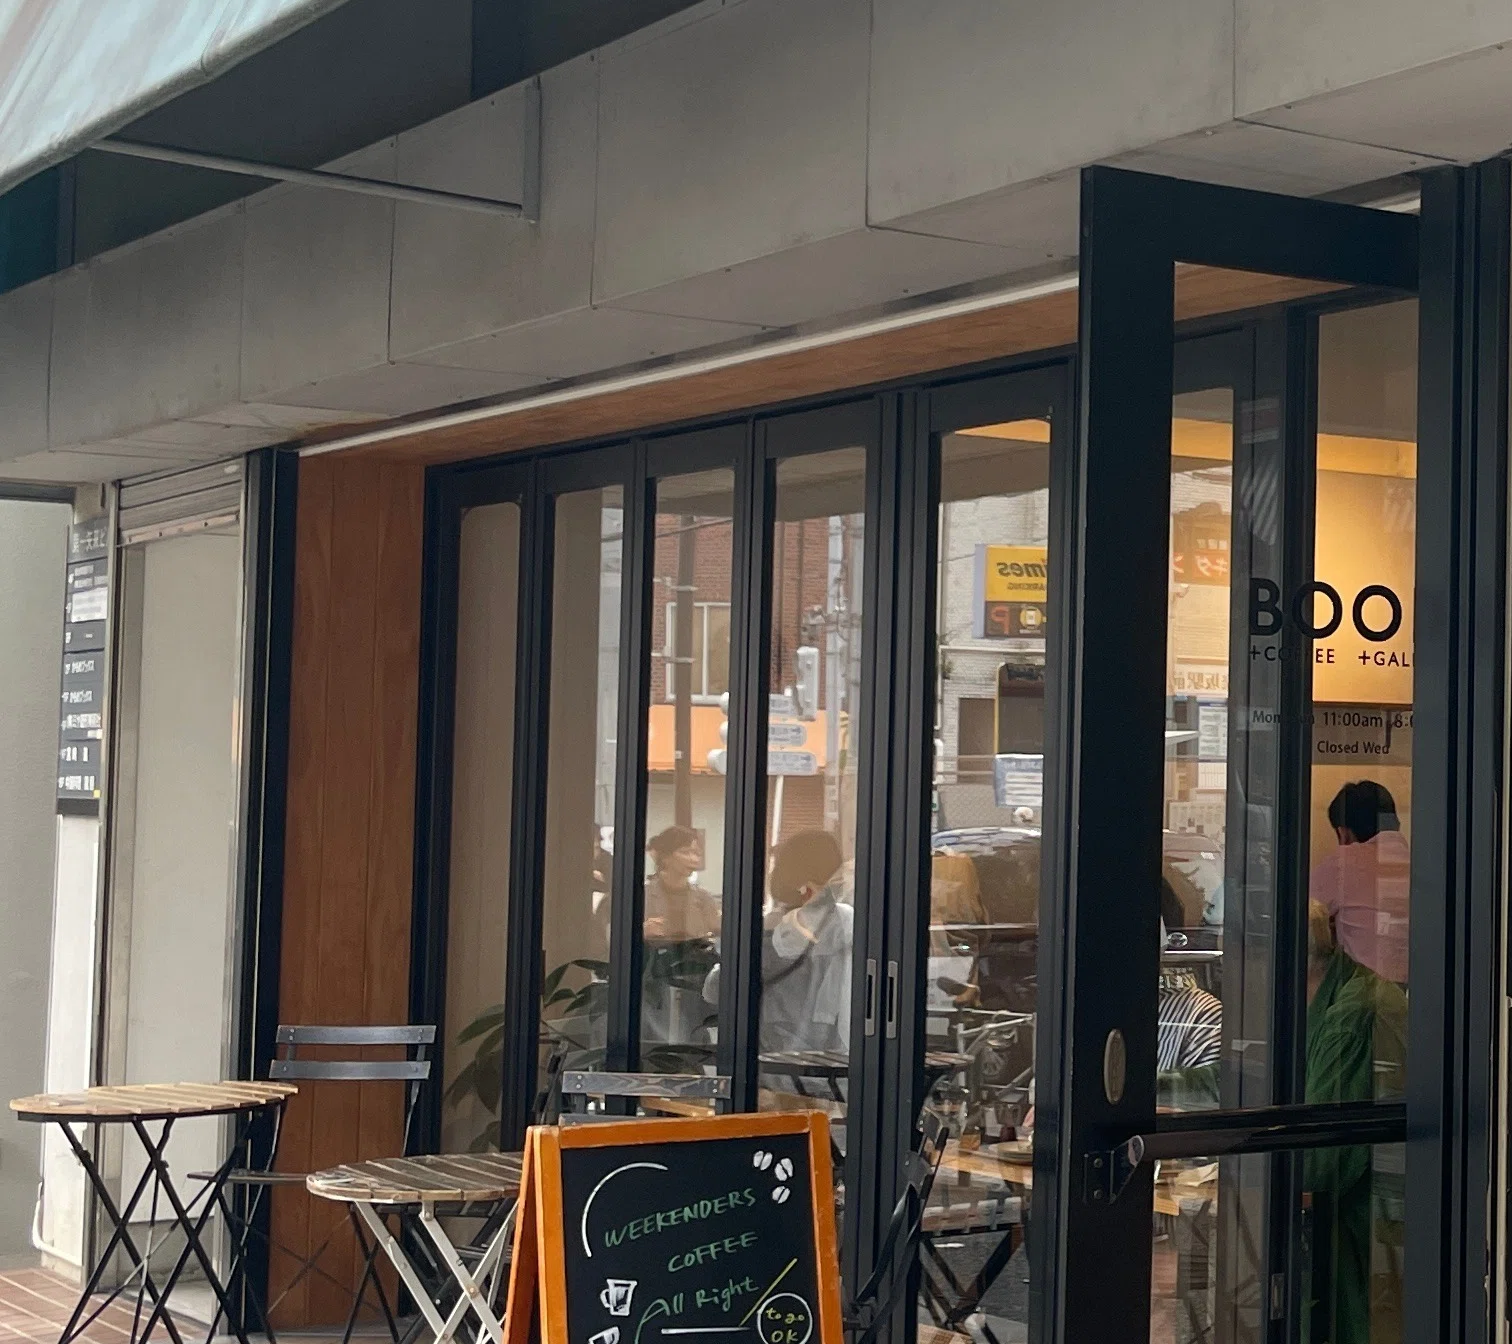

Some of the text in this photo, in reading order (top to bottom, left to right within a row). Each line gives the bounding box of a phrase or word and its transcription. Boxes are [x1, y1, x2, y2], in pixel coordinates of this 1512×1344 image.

[1323, 712, 1383, 727] 11:00am
[1317, 741, 1390, 755] Closed Wed
[604, 1187, 757, 1248] WEEKENDERS
[668, 1231, 759, 1273] COFFEE
[695, 1276, 760, 1312] Right
[765, 1307, 782, 1321] to
[771, 1329, 799, 1344] OK
